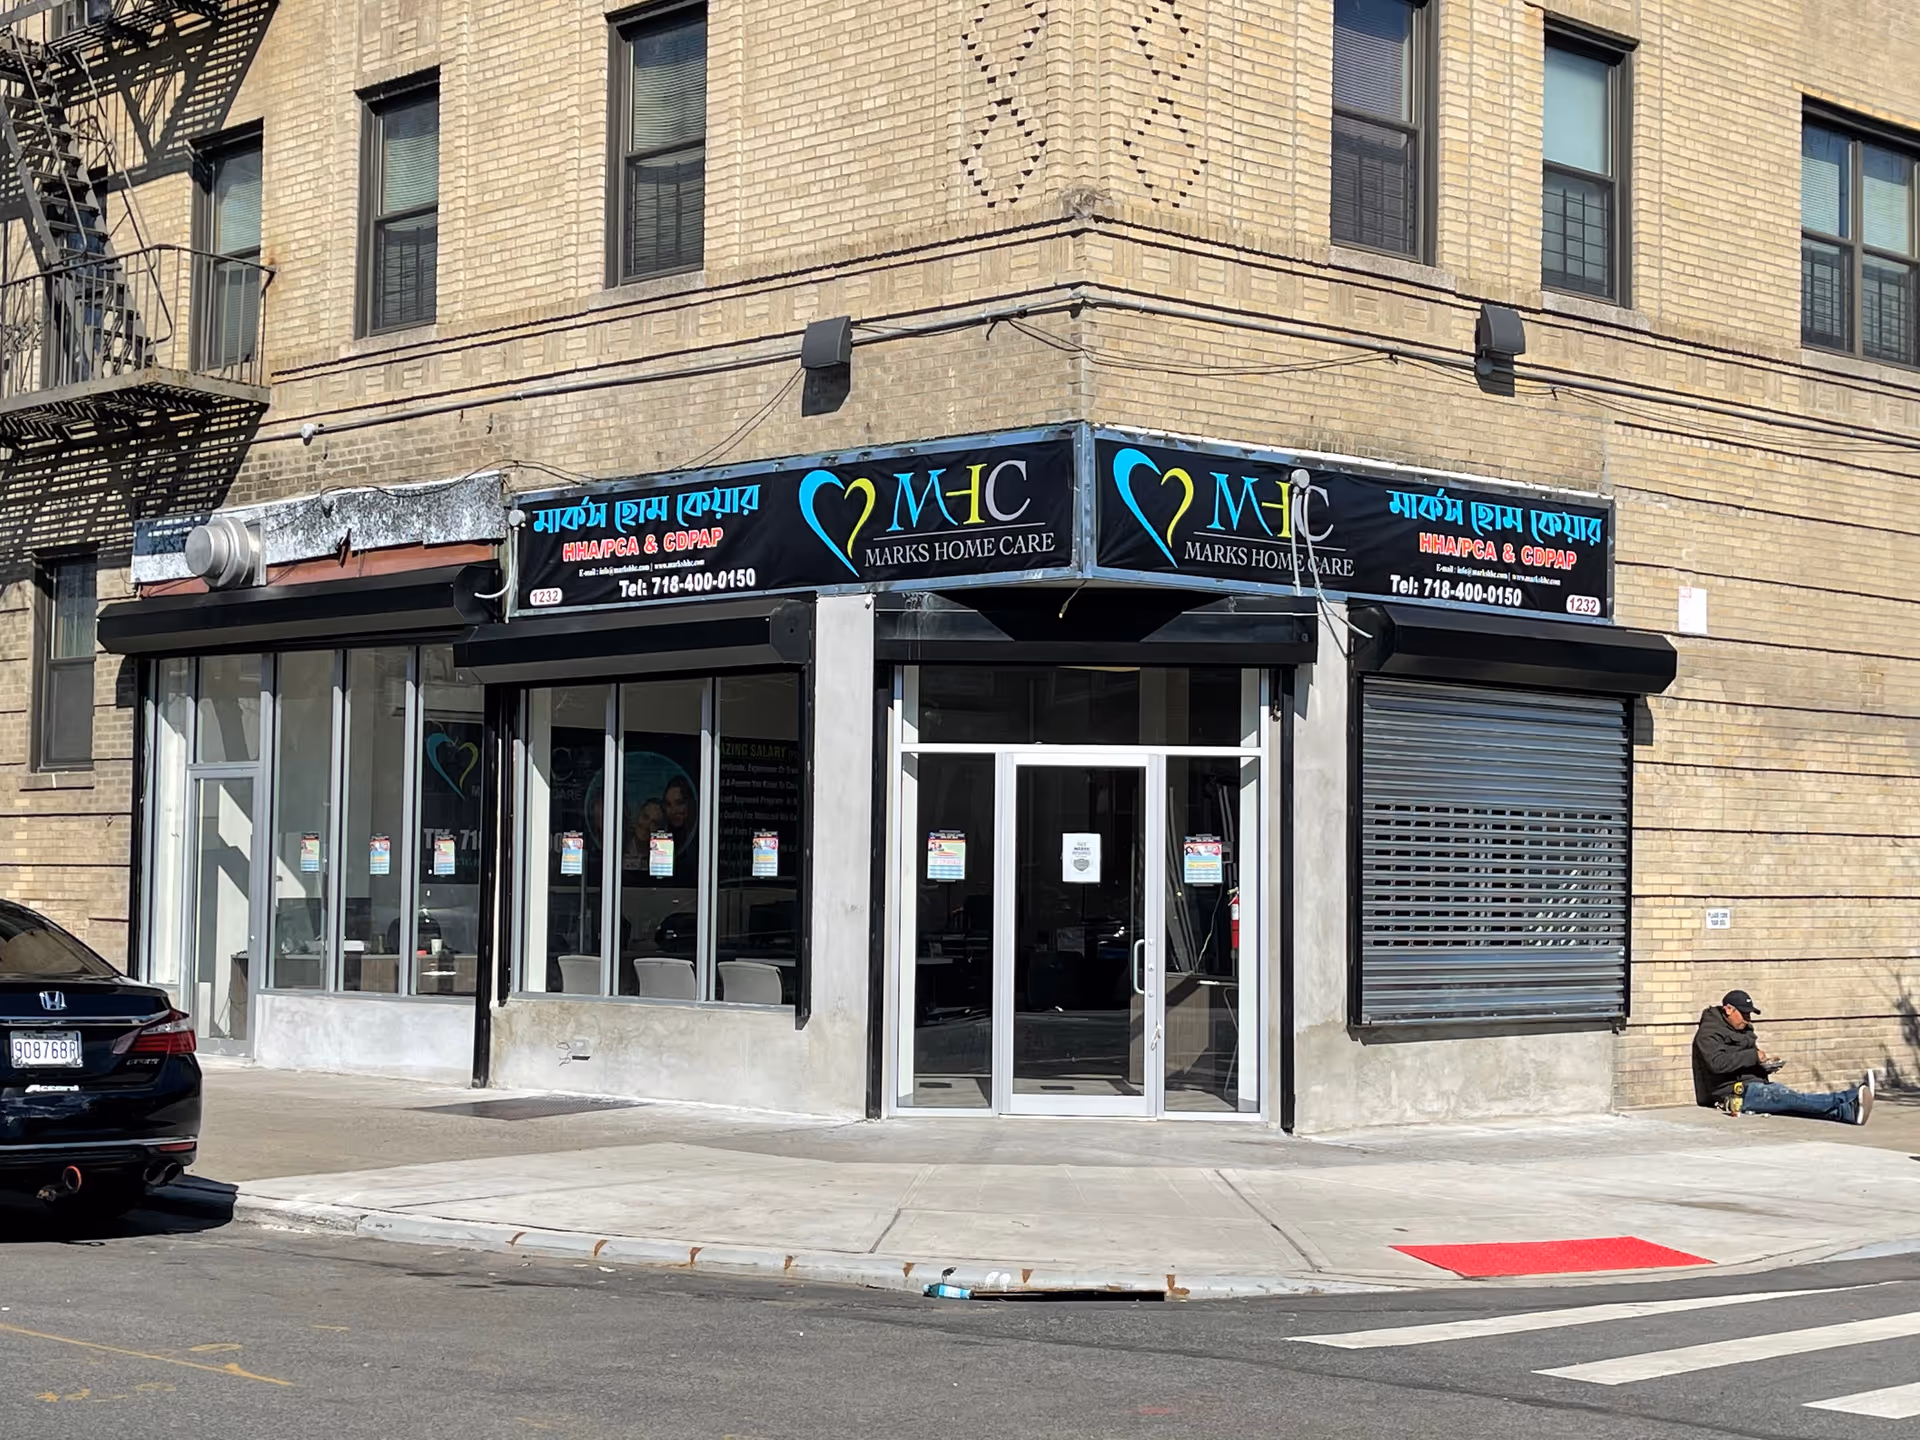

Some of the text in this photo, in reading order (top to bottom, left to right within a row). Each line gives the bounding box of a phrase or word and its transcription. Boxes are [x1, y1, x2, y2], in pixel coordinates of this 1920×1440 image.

[614, 496, 669, 534] হোম
[677, 484, 761, 527] কেয়ার
[886, 459, 1031, 532] MHC
[1470, 501, 1523, 536] হোম
[1530, 509, 1602, 546] কেয়ার
[563, 527, 723, 562] HHA/PCA & CDPAP
[864, 532, 1056, 568] MARKS HOME CARE
[1184, 540, 1355, 577] MARKS HOME CARE
[1419, 531, 1577, 571] HHA/PCA & CDPAP
[532, 590, 558, 604] 1232
[619, 567, 756, 598] Tel: 718-400-0150
[1390, 574, 1522, 607] Tel: 718-400-0150
[1569, 597, 1597, 613] 1232
[751, 744, 787, 758] SALARY
[14, 1041, 77, 1060] 908768R
